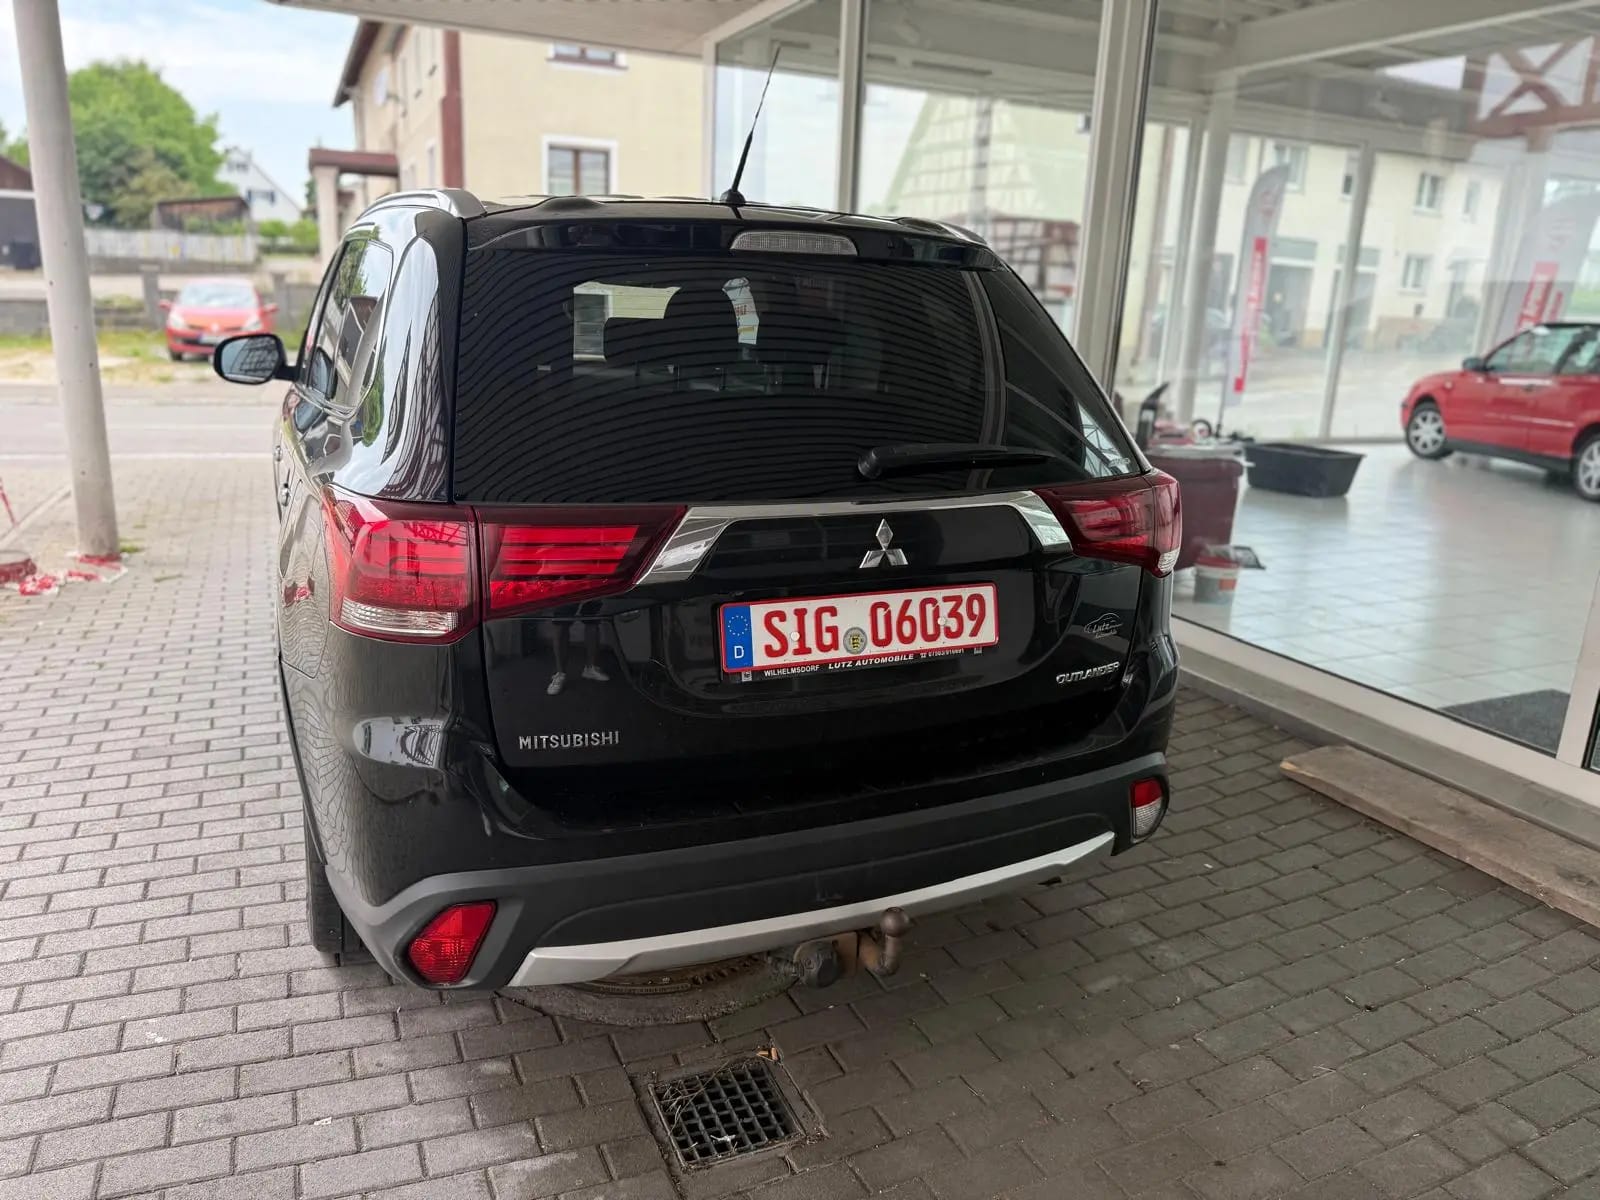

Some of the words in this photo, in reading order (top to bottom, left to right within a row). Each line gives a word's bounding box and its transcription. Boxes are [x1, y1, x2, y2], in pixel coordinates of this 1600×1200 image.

[764, 606, 839, 658] SIG
[869, 593, 986, 647] 06039
[734, 646, 744, 658] D
[764, 665, 820, 677] WILHELMSDORF
[828, 661, 852, 669] LUTZ
[855, 653, 914, 667] AUTOMOBILE
[1056, 661, 1120, 684] OUTLANDER
[519, 731, 619, 750] MITSUBISHI
